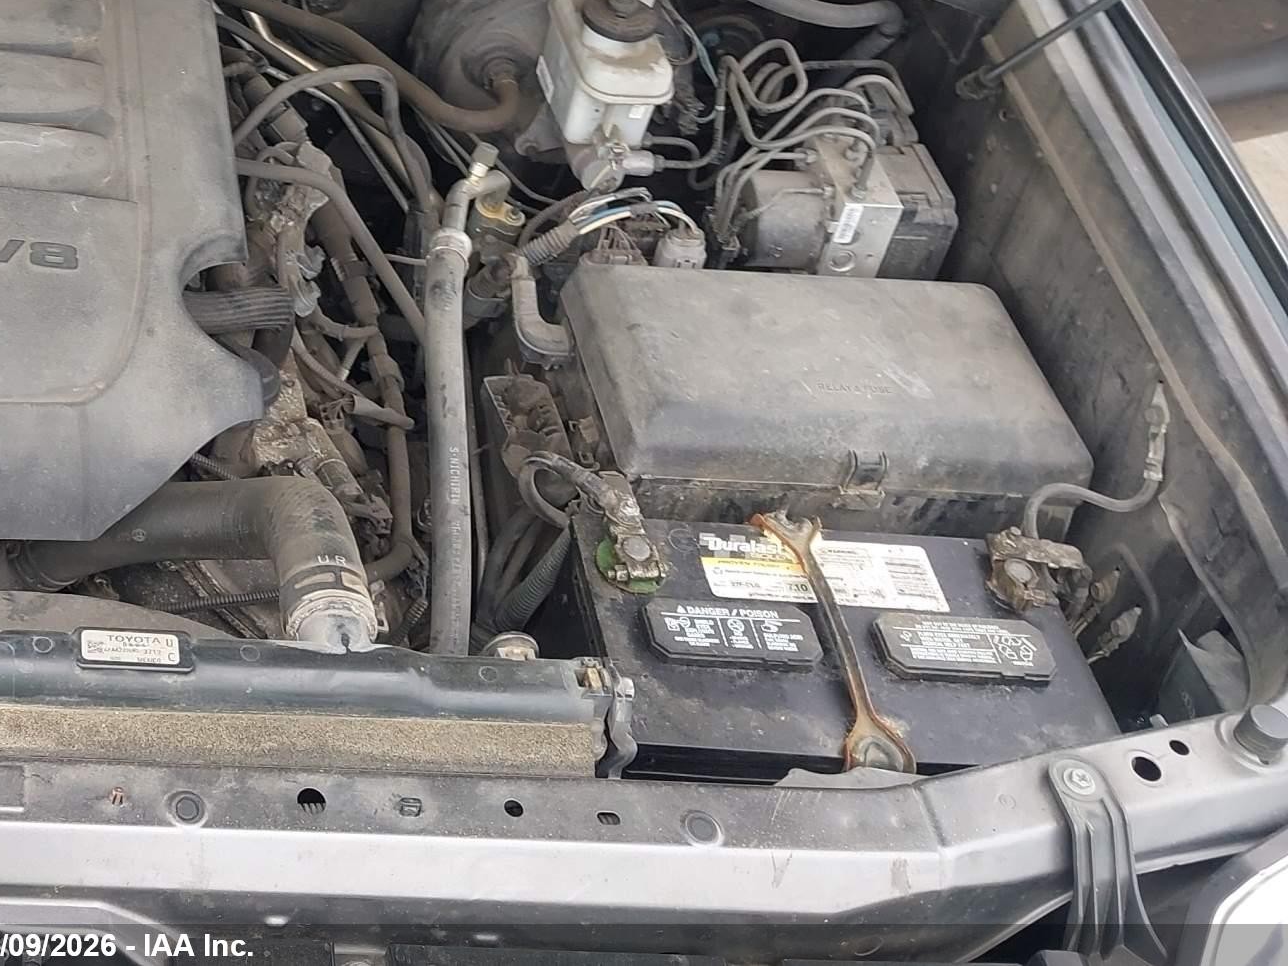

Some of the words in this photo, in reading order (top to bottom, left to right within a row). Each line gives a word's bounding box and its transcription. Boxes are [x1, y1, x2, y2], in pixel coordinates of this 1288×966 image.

[686, 606, 730, 616] DANGER
[739, 608, 779, 619] POISON
[106, 634, 161, 645] TOYOTA
